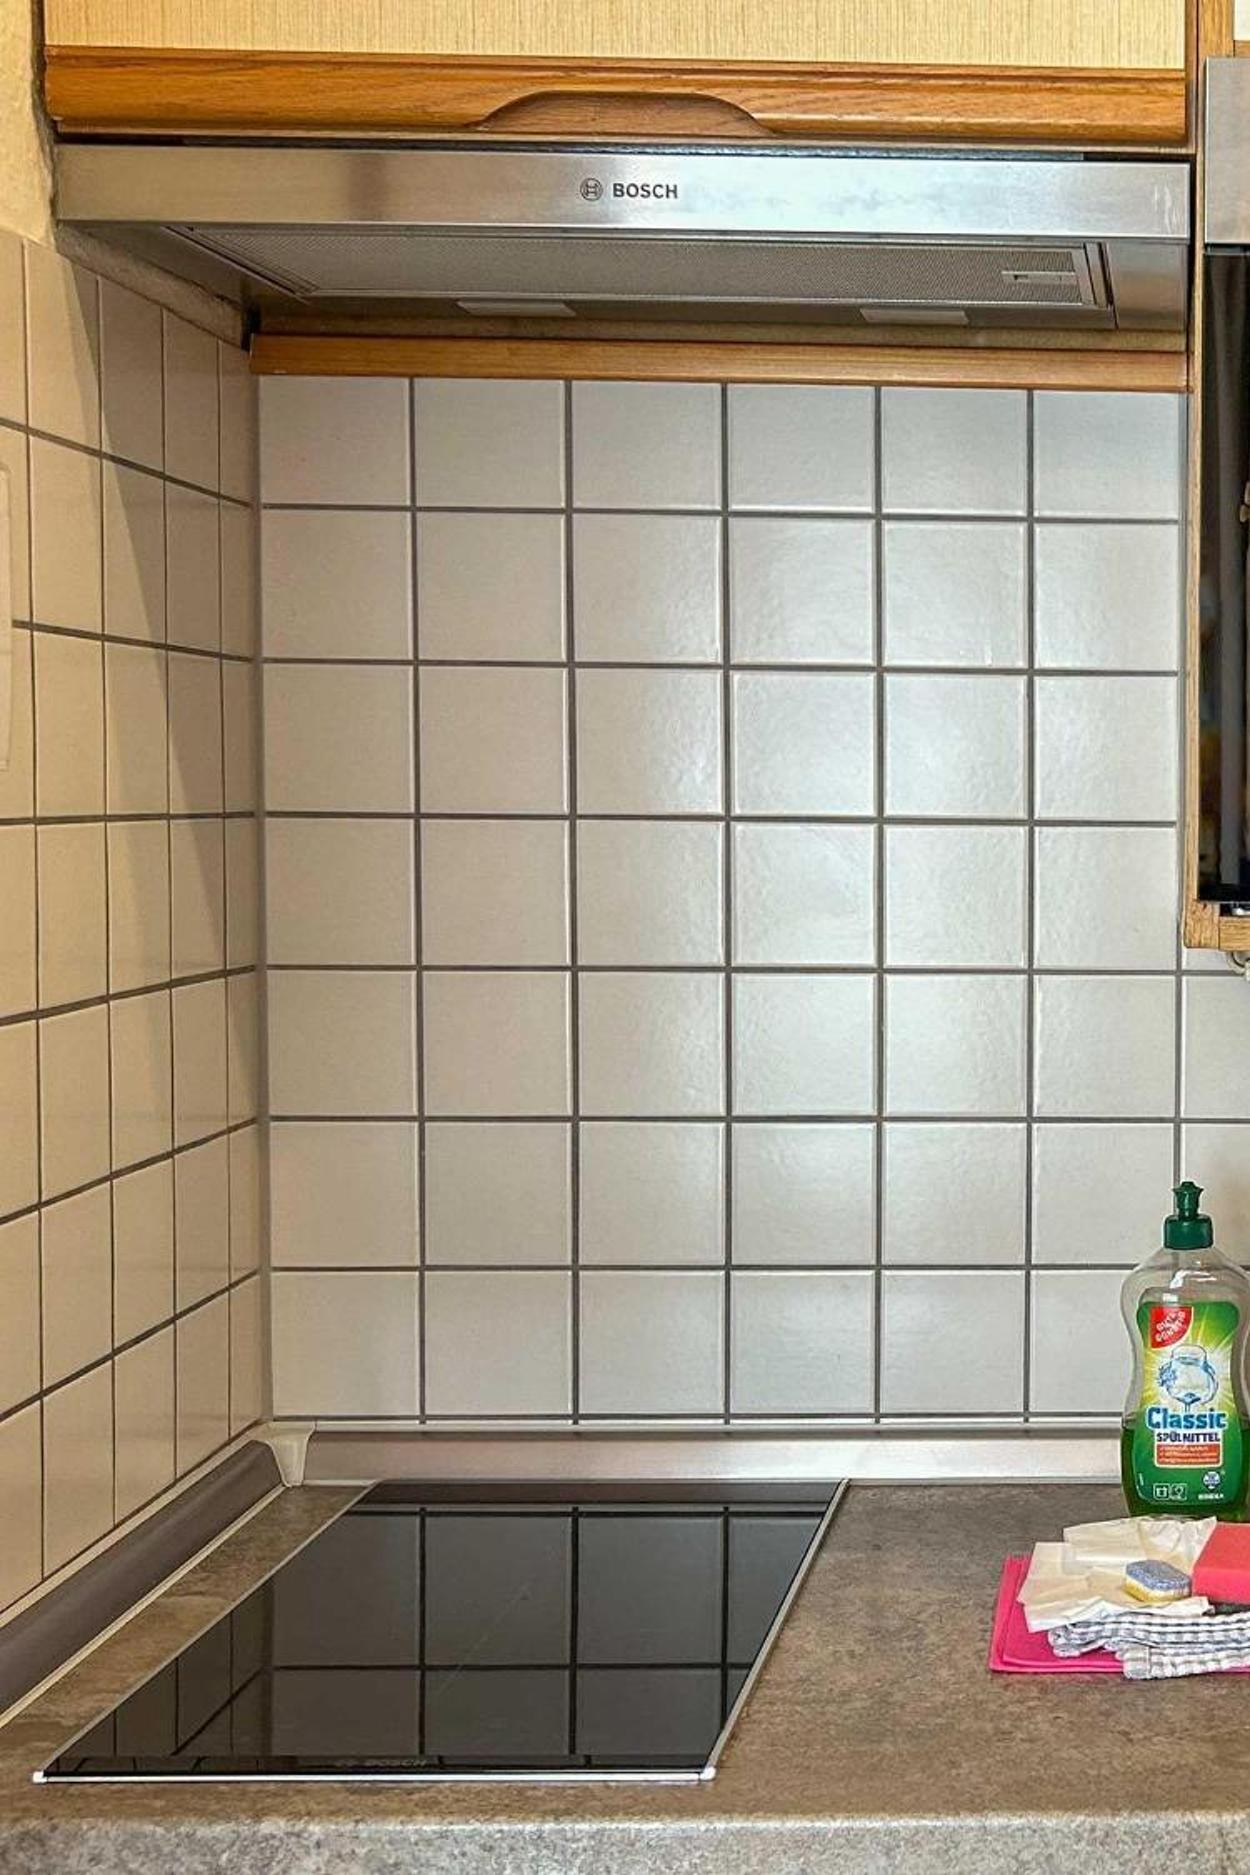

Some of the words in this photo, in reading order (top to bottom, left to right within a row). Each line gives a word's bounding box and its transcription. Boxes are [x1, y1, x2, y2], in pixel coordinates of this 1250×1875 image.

[612, 182, 679, 200] BOSCH
[1147, 1406, 1227, 1430] Classic
[1156, 1431, 1221, 1442] SPÜLMITTEL
